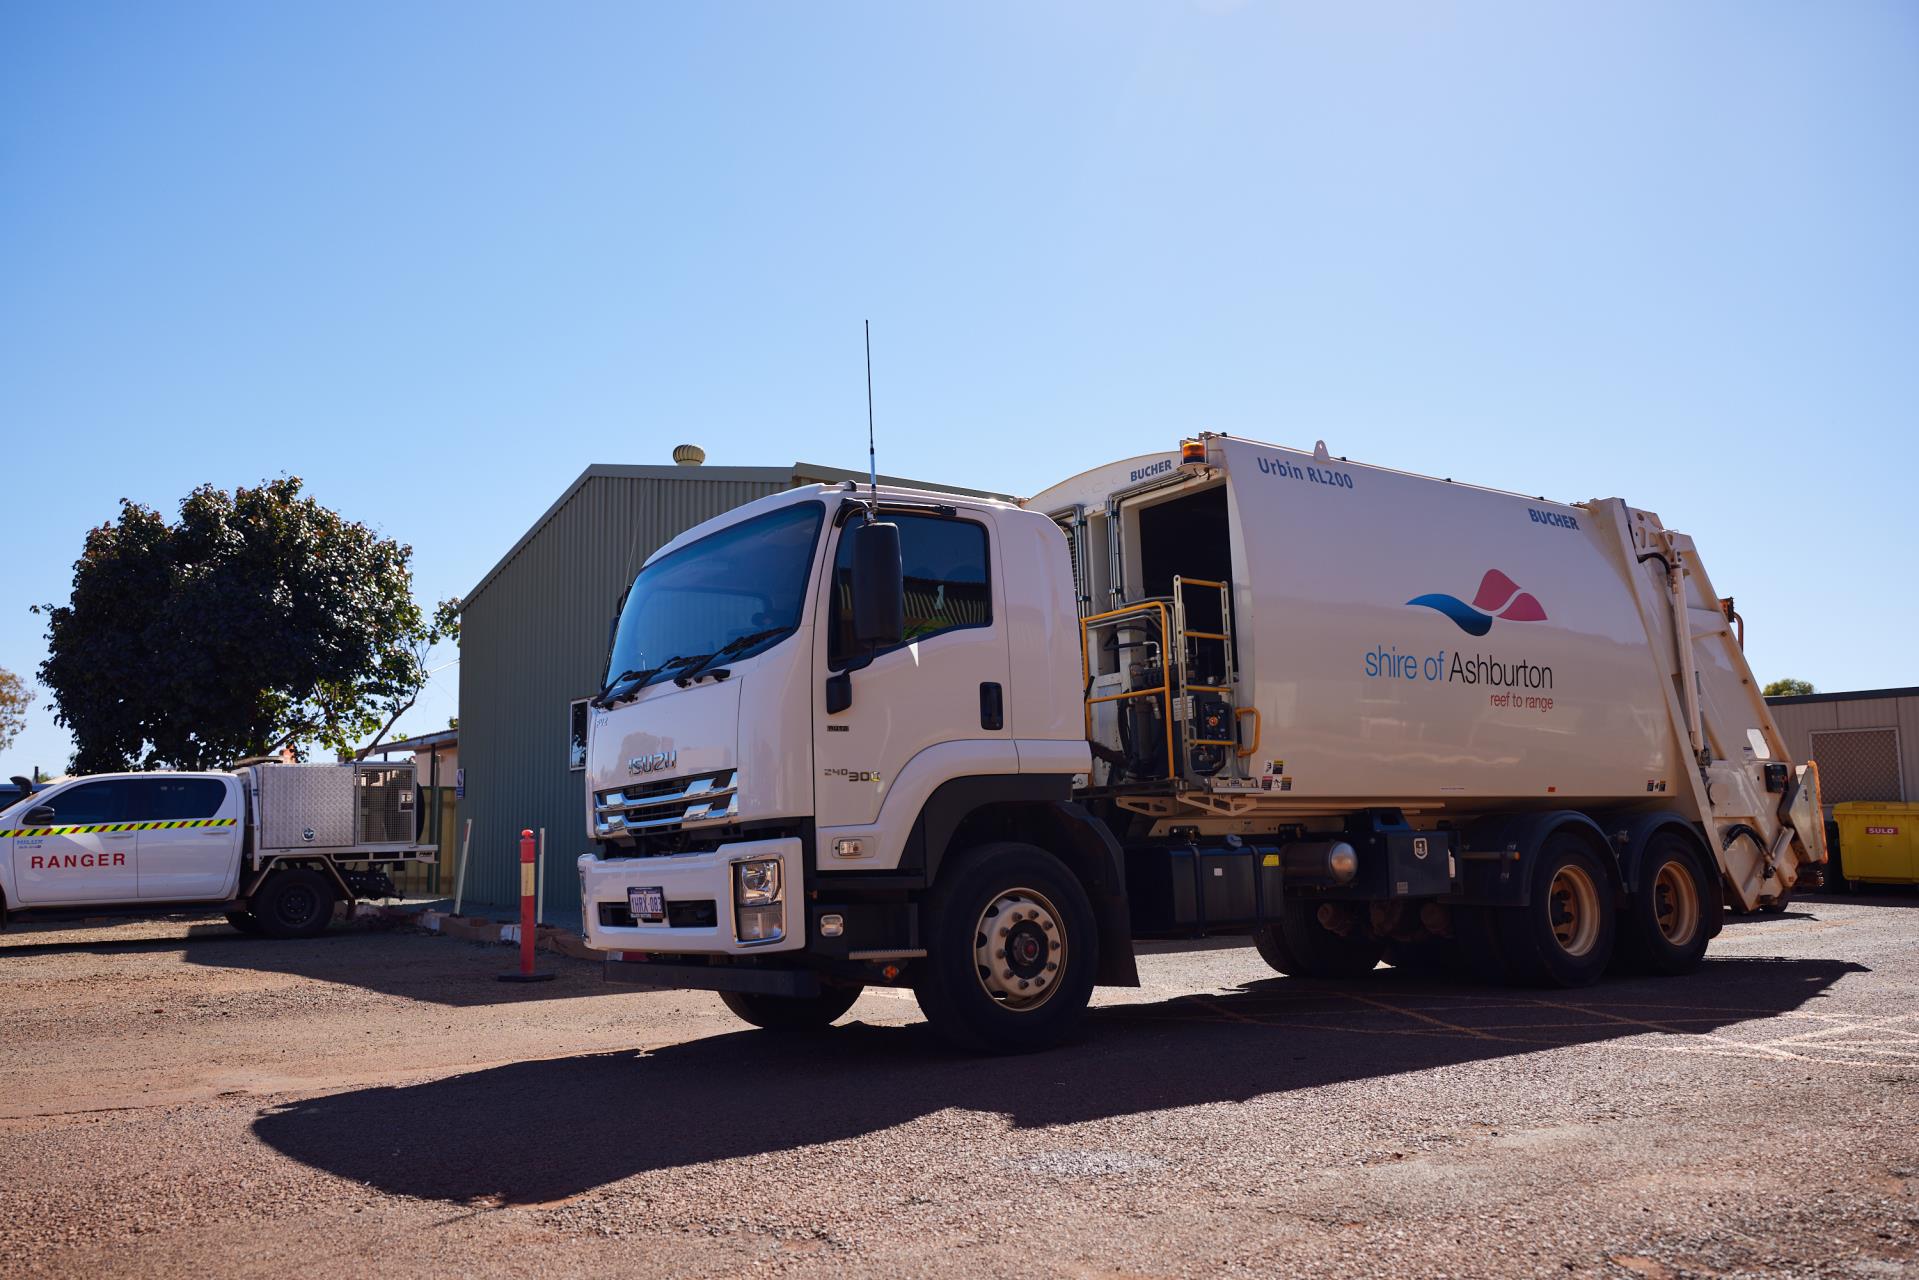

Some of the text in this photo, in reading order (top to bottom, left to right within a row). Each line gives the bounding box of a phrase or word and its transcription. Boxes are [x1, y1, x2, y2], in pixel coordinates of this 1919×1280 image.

[1130, 459, 1172, 482] BUCHER
[1257, 457, 1353, 489] Urbin RL200
[1528, 508, 1580, 531] BUCHER
[1365, 645, 1553, 689] shire of Ashburton
[1490, 692, 1554, 712] reef to range
[628, 749, 677, 777] ISUZU
[31, 853, 125, 869] RANGER
